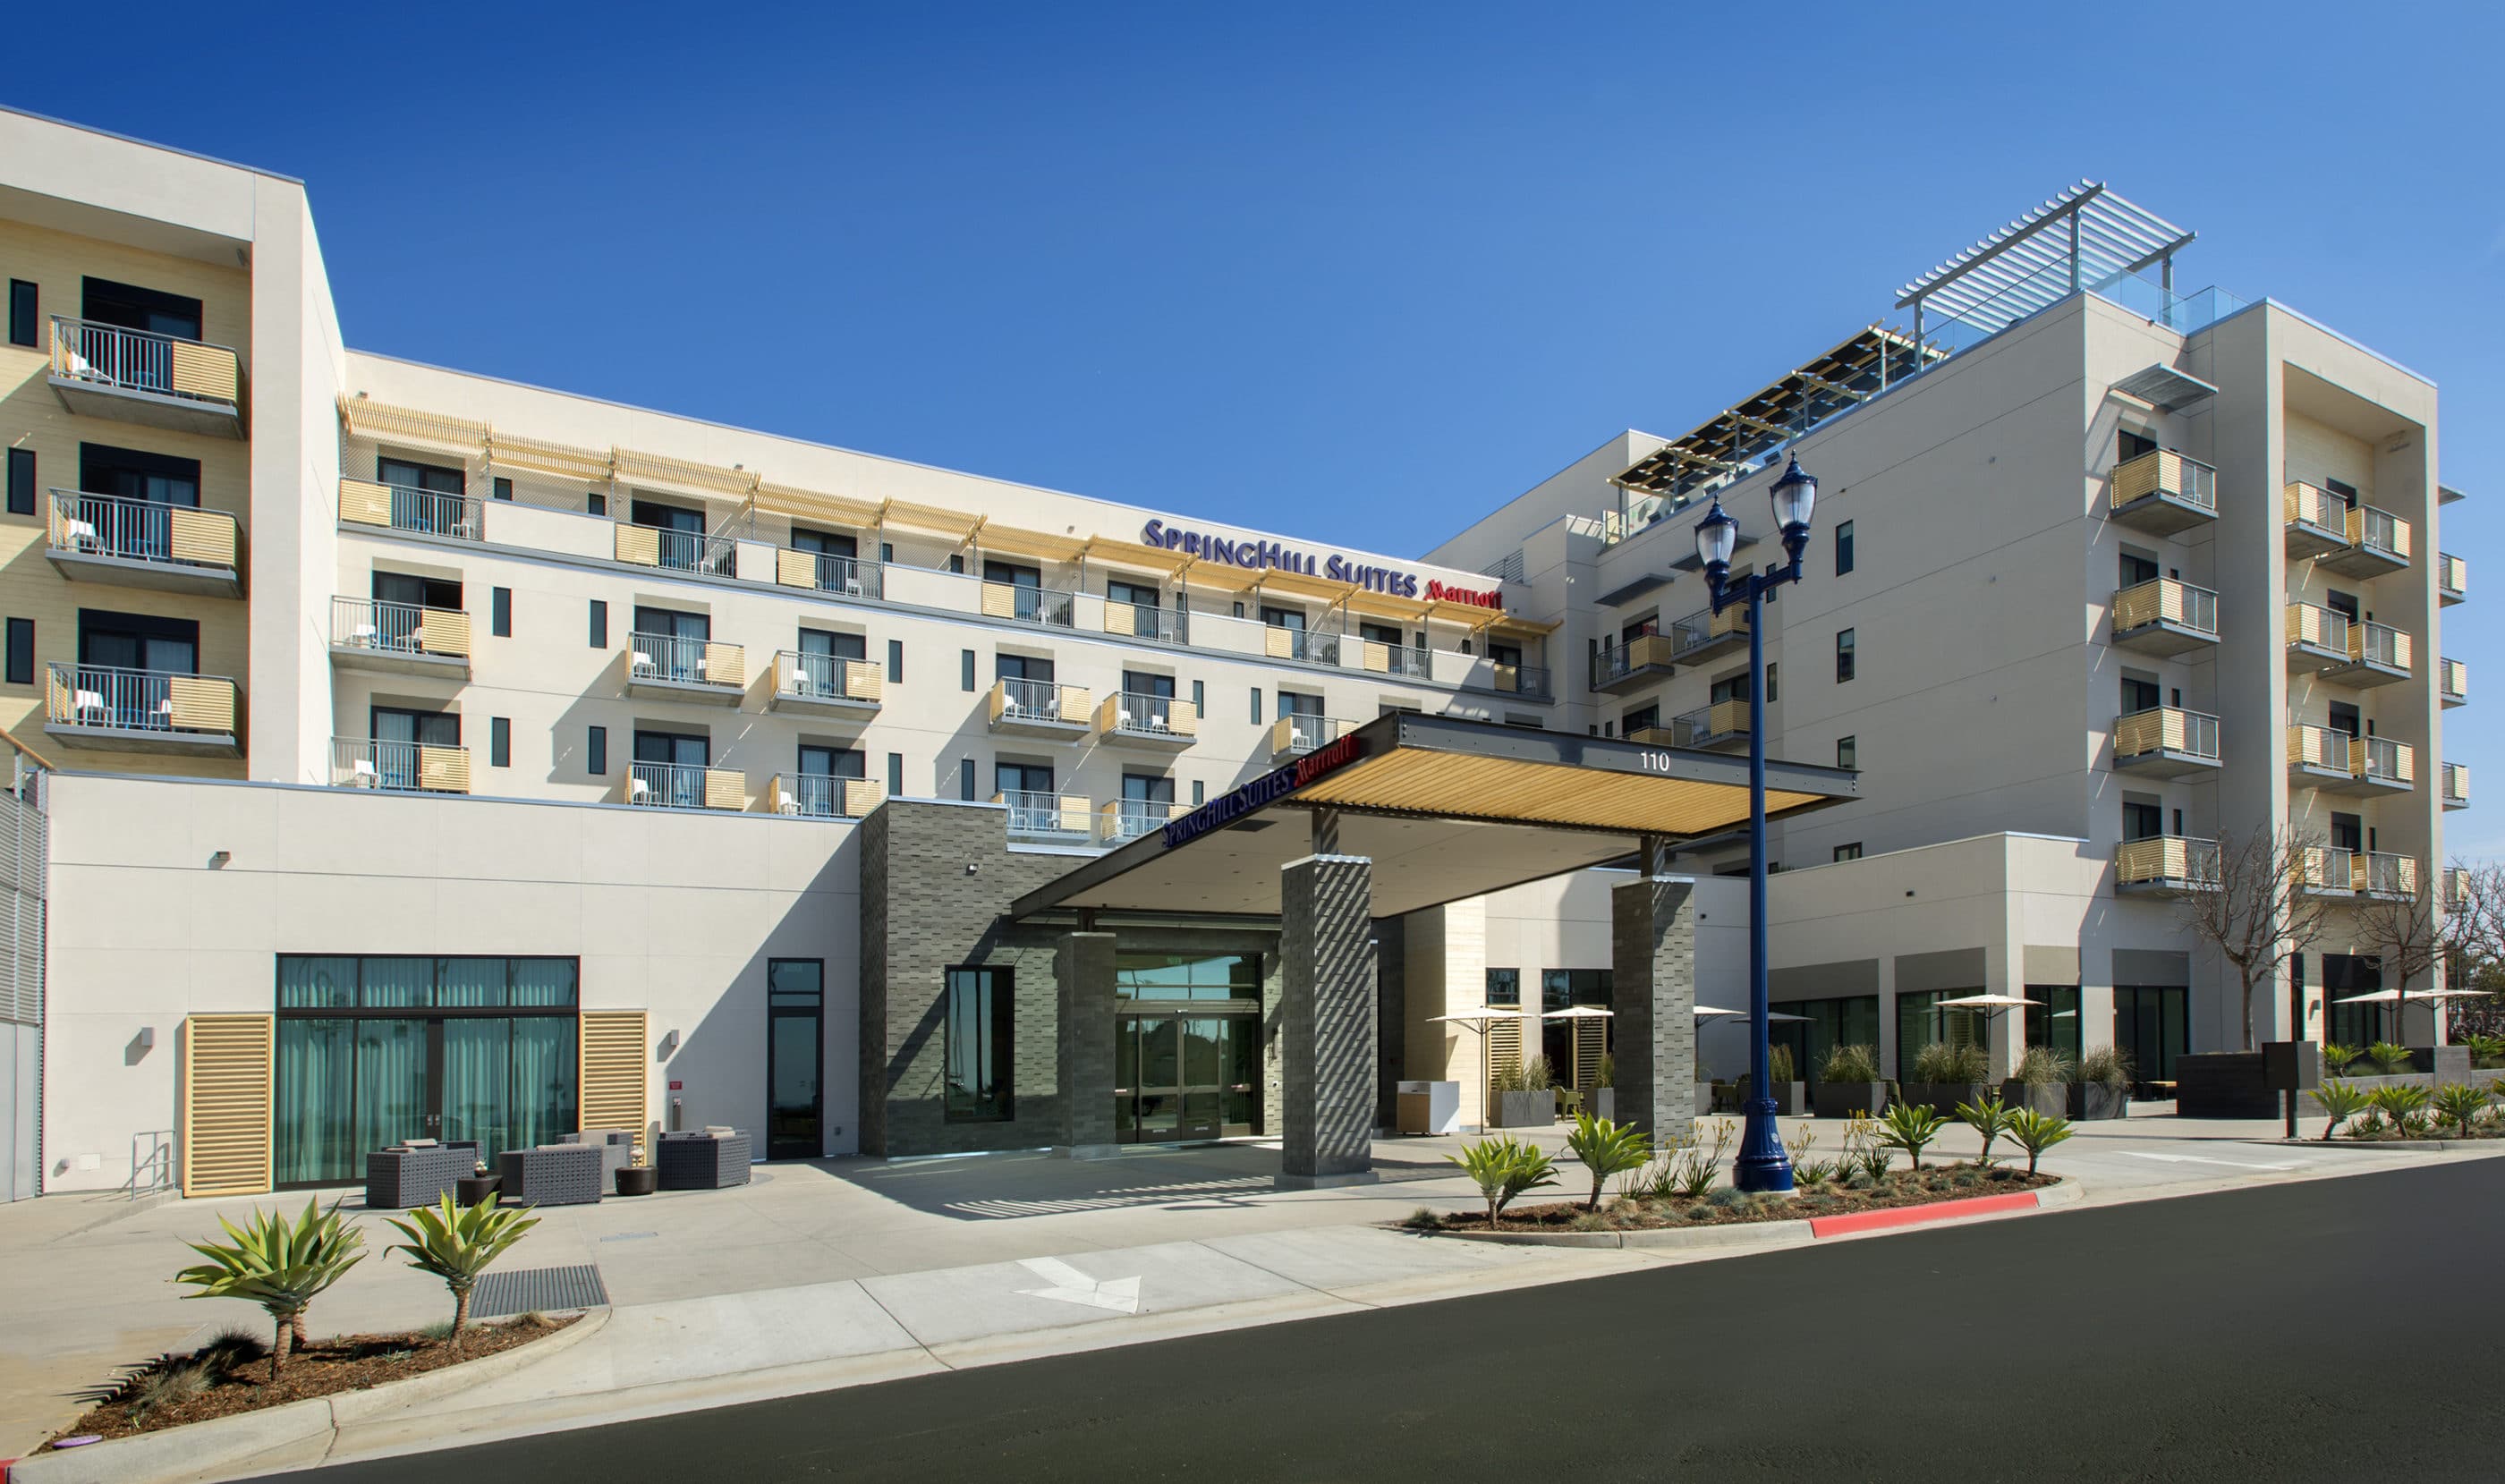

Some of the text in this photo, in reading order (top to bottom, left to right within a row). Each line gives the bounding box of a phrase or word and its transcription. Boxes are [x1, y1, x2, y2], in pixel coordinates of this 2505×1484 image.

[1328, 554, 1418, 598] SUITES
[1424, 579, 1504, 610] Marriott
[1239, 767, 1293, 812] SUITES
[1295, 734, 1355, 787] Marriott
[1641, 750, 1669, 771] 110
